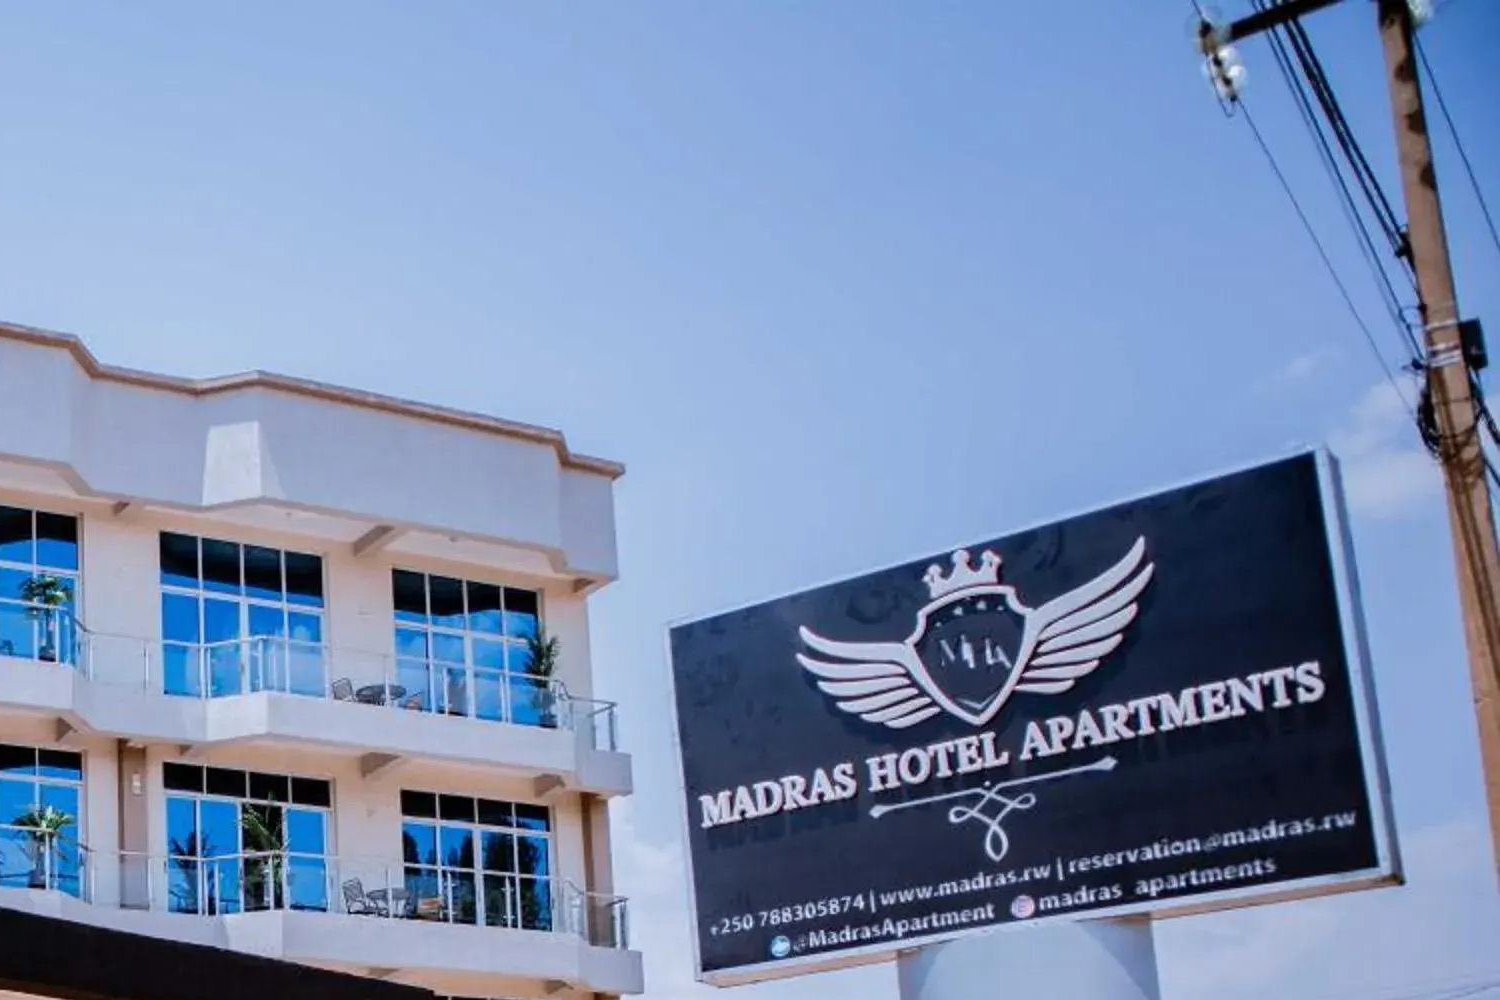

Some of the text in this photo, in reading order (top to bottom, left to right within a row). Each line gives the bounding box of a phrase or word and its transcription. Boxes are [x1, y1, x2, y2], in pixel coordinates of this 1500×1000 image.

[699, 661, 1326, 828] MADRAS HOTEL APARTMENTS
[758, 898, 865, 927] 788305874
[879, 862, 1051, 906] www.madras.rw
[1068, 808, 1357, 875] reservation@madras.rw
[792, 902, 995, 953] @MadrasApartment
